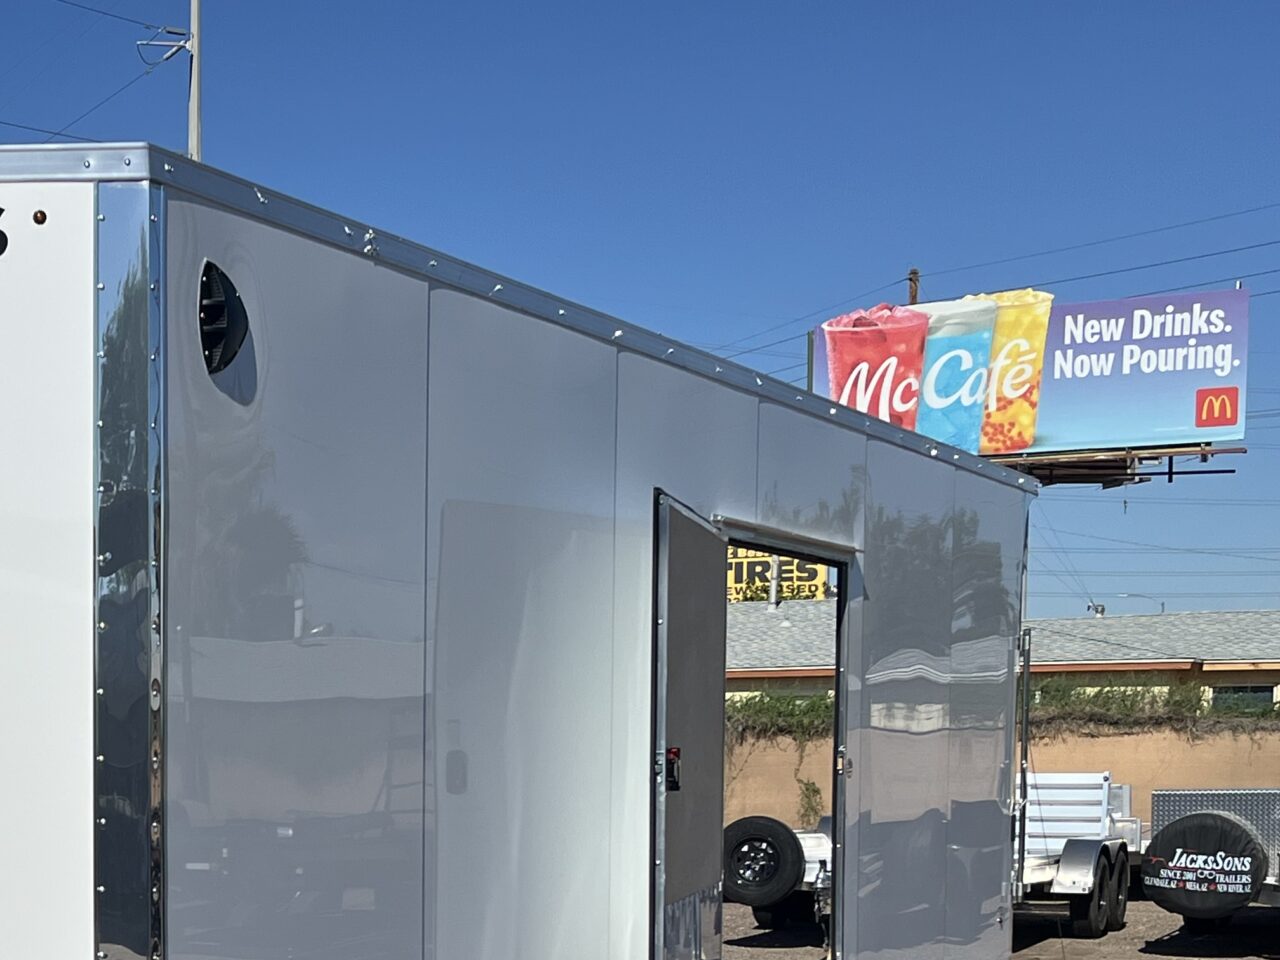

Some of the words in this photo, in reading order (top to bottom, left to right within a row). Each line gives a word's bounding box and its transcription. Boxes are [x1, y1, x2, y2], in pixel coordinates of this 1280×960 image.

[1064, 313, 1124, 344] New
[1132, 303, 1232, 337] Drinks.
[1054, 349, 1114, 380] Now
[1122, 341, 1240, 377] Pouring.
[1159, 868, 1181, 880] SINCE
[1215, 873, 1252, 883] TRAILERS
